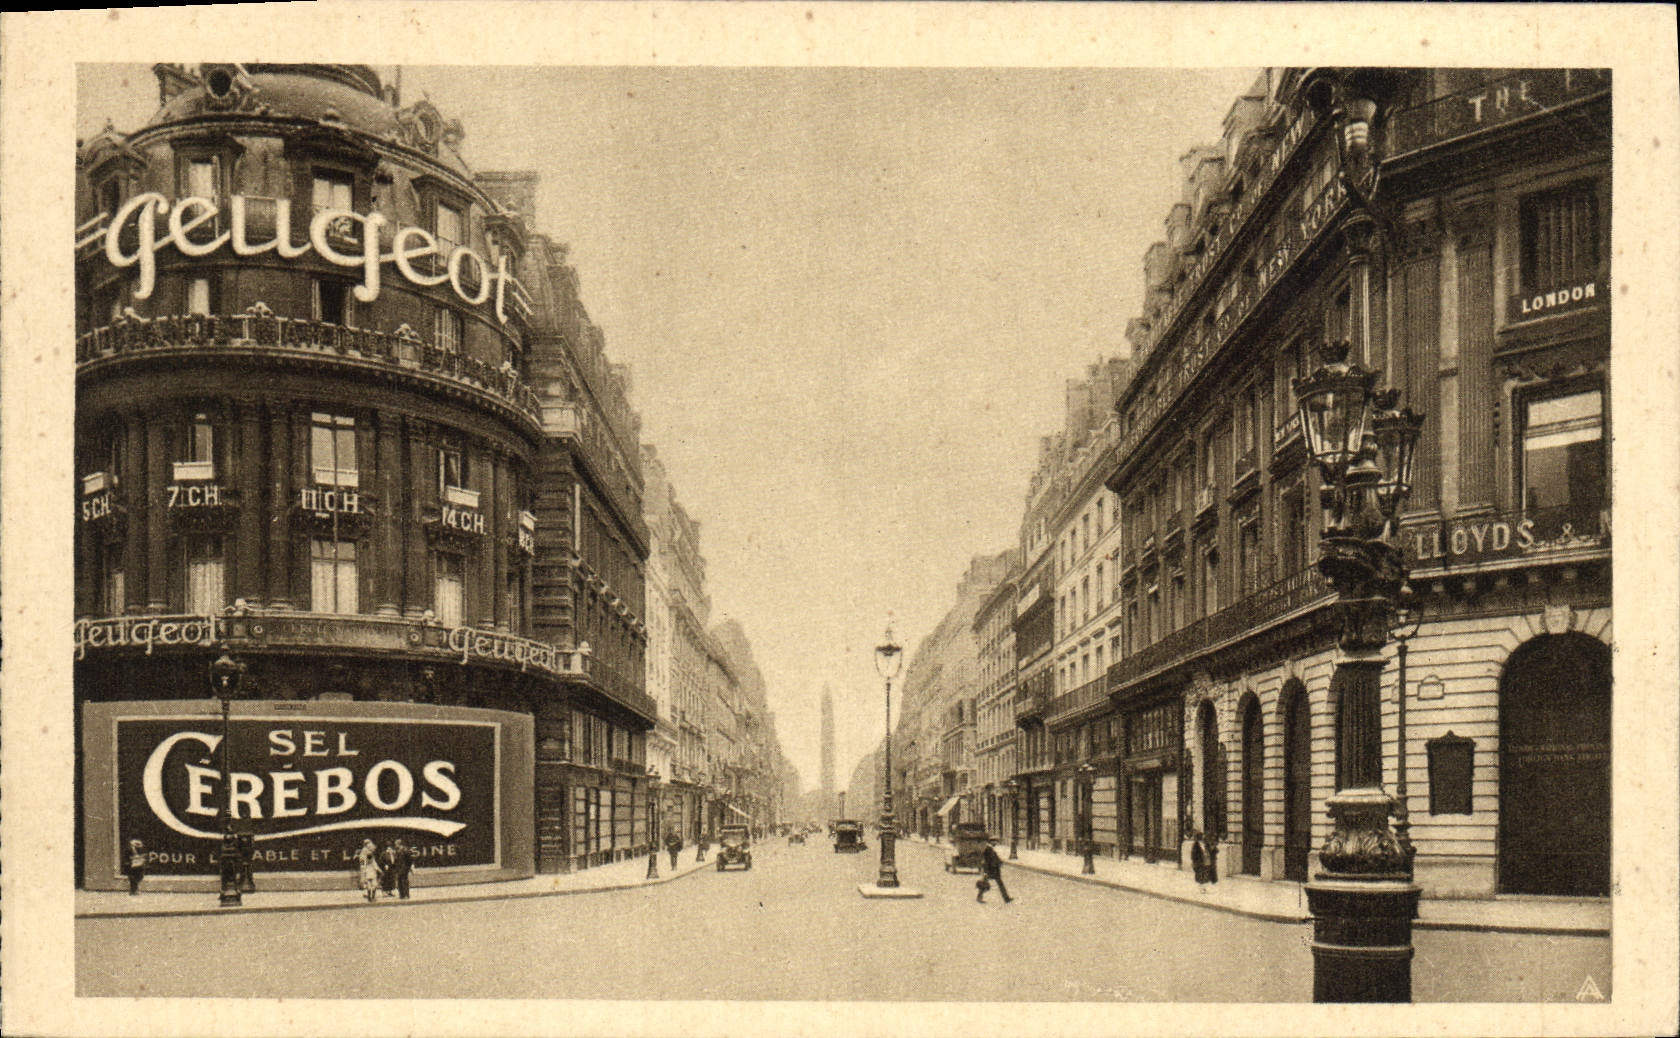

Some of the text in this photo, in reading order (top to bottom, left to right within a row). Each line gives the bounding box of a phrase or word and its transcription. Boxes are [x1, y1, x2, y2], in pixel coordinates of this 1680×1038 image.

[1521, 282, 1597, 314] LONDON
[269, 729, 360, 758] SEL
[143, 731, 467, 841] CÉRÉBOS
[150, 851, 197, 864] POUR
[251, 849, 300, 862] ABLE
[311, 849, 332, 861] ET
[409, 844, 456, 858] SINE
